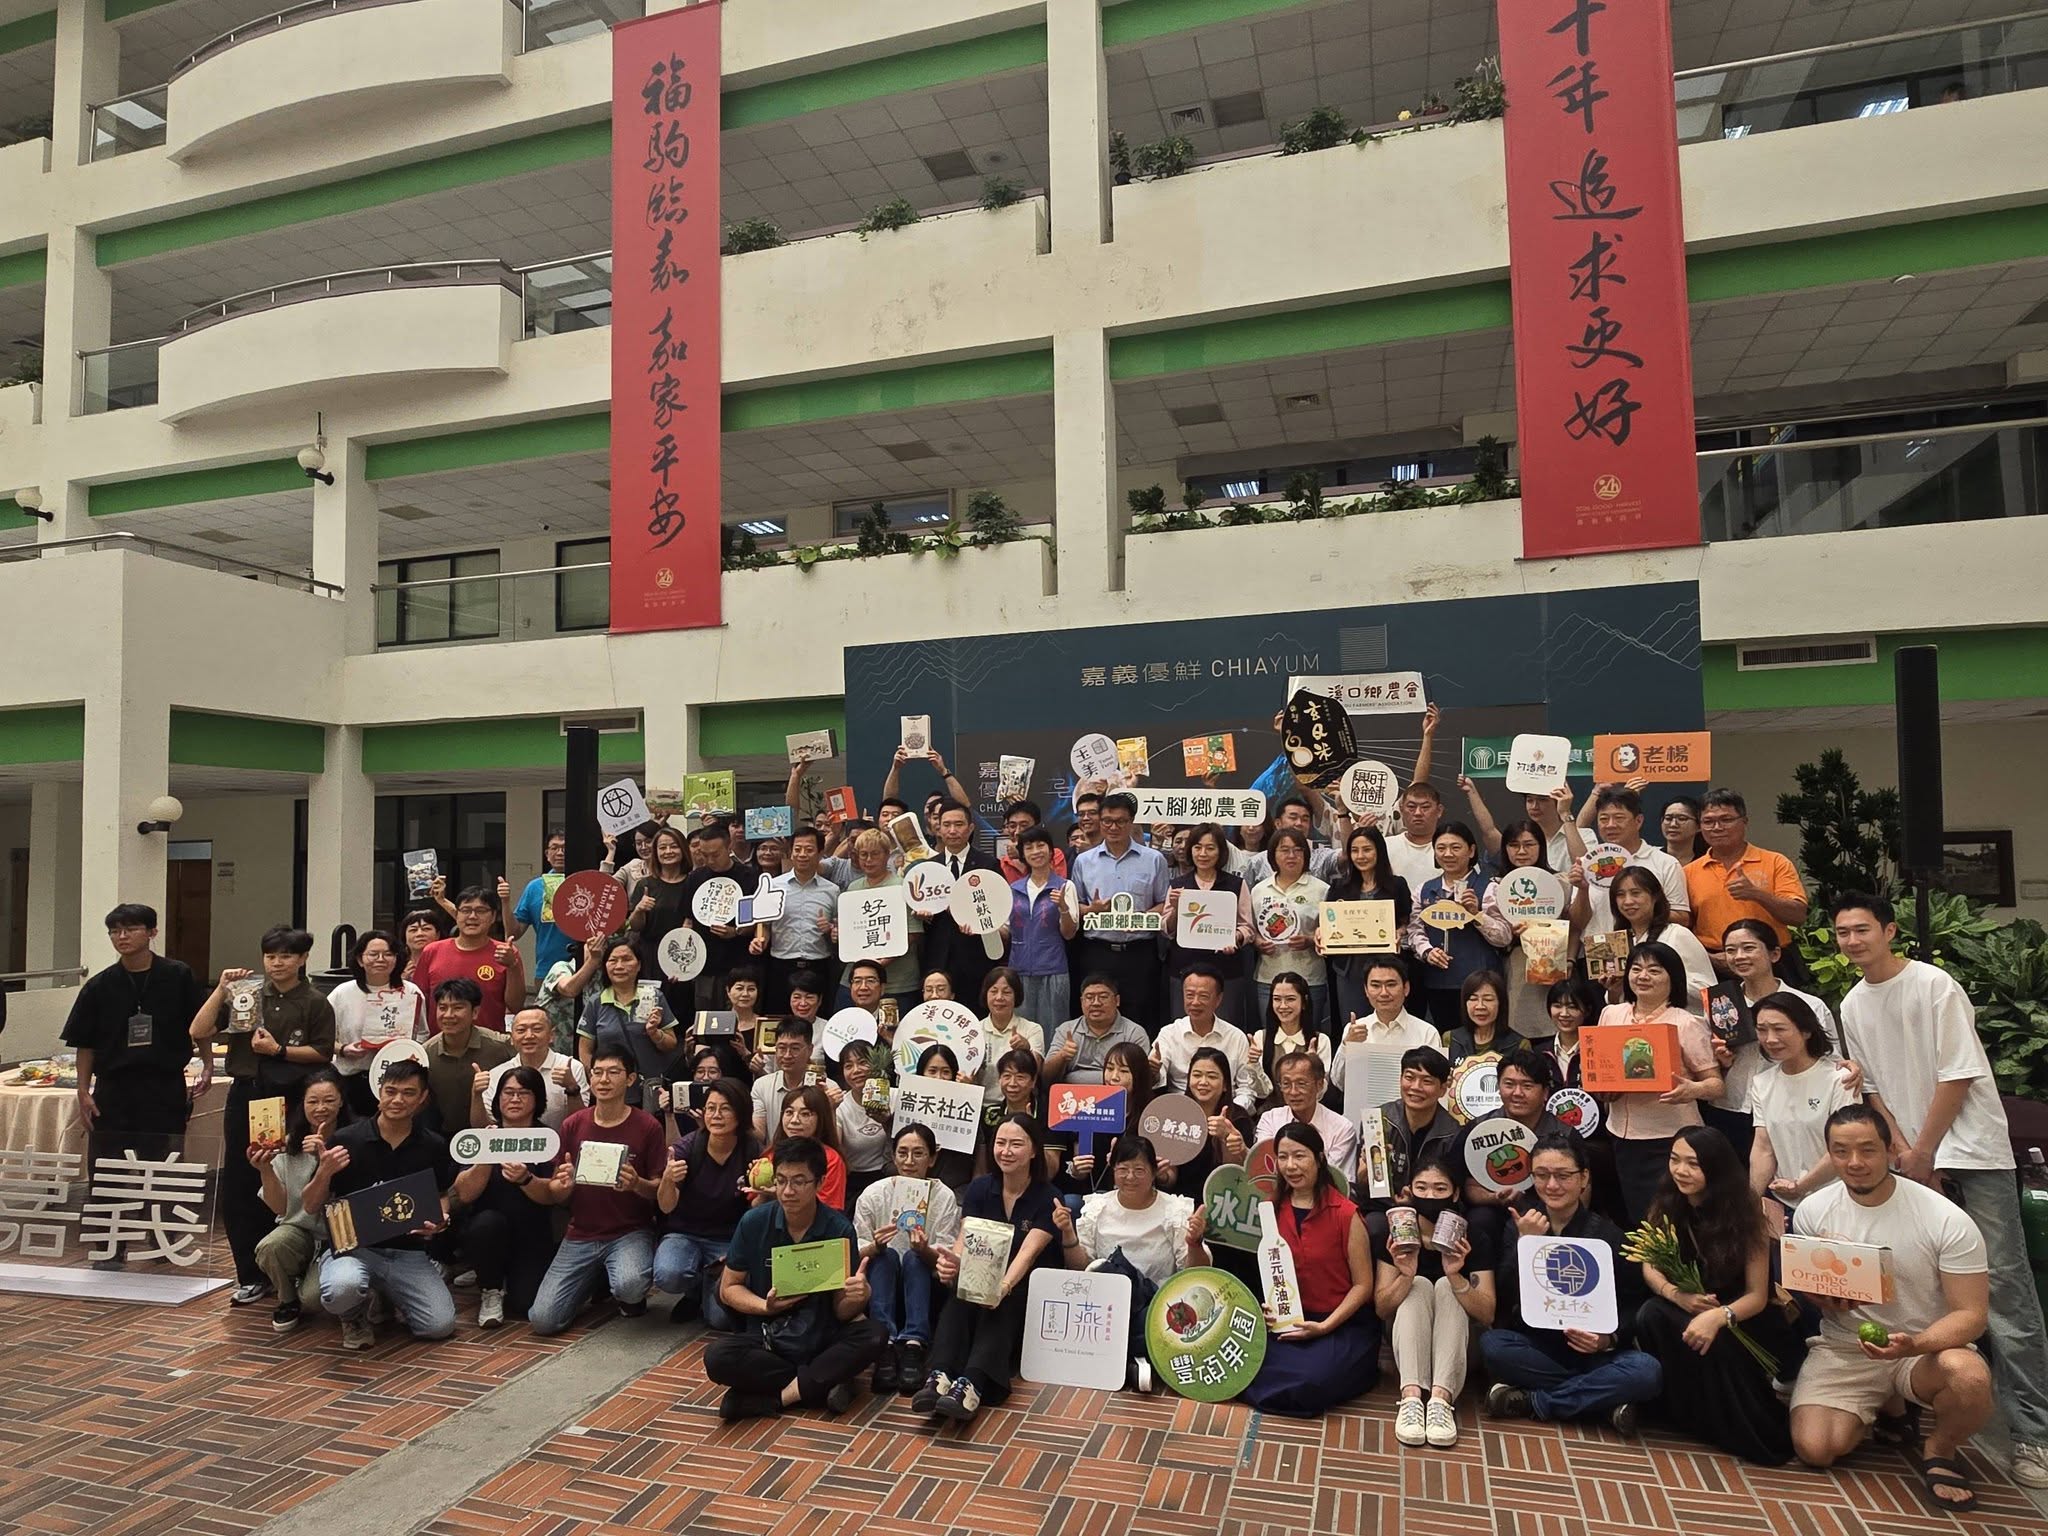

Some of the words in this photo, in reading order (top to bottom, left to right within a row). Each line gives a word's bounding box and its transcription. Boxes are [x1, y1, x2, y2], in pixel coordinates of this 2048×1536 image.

[1080, 661, 1202, 687] 嘉義優鮮
[1211, 653, 1320, 678] CHIAYUM
[1328, 682, 1420, 701] 溪口鄉農會
[1643, 745, 1689, 764] 老楊
[979, 762, 999, 778] 嘉
[1659, 765, 1689, 773] FOOD
[979, 781, 998, 799] 優
[980, 803, 1006, 813] CHIA
[1143, 796, 1262, 818] 六腳鄉農會
[1085, 914, 1160, 929] 六腳鄉農會
[922, 1005, 979, 1061] 溪口鄉農會
[900, 1090, 975, 1122] 崙禾社企
[1162, 1118, 1202, 1139] 新東陽
[0, 1144, 208, 1266] 嘉義
[1268, 1248, 1291, 1316] 清元製油廠
[1792, 1268, 1848, 1287] Orange
[1816, 1284, 1873, 1301] Pickers
[1170, 1306, 1257, 1386] 豐碩果園
